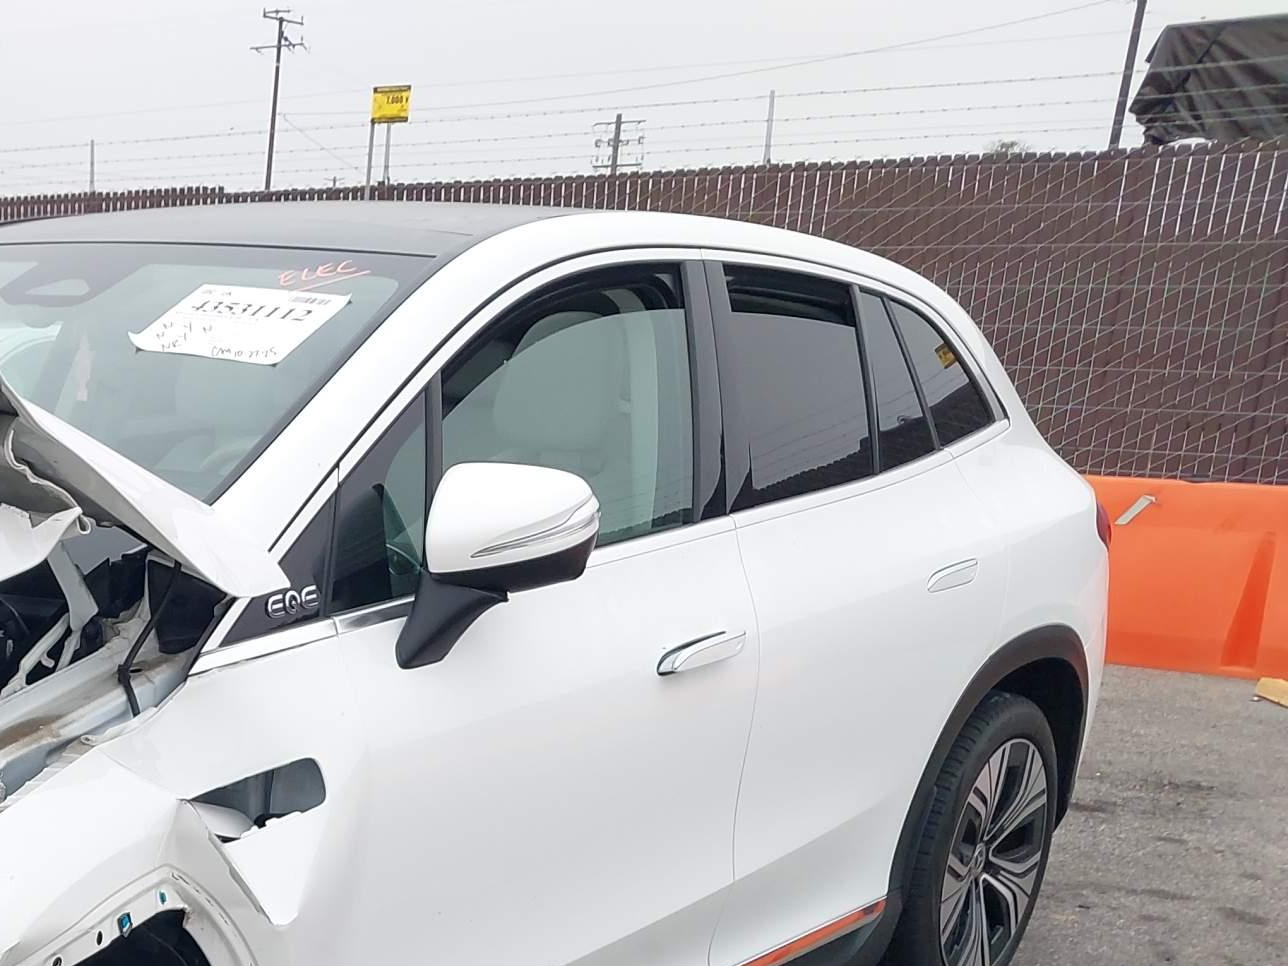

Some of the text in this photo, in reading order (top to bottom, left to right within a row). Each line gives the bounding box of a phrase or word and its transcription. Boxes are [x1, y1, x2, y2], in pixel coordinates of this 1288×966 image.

[278, 259, 358, 287] ELEC
[190, 299, 314, 322] 43531112
[267, 585, 320, 618] EQE
